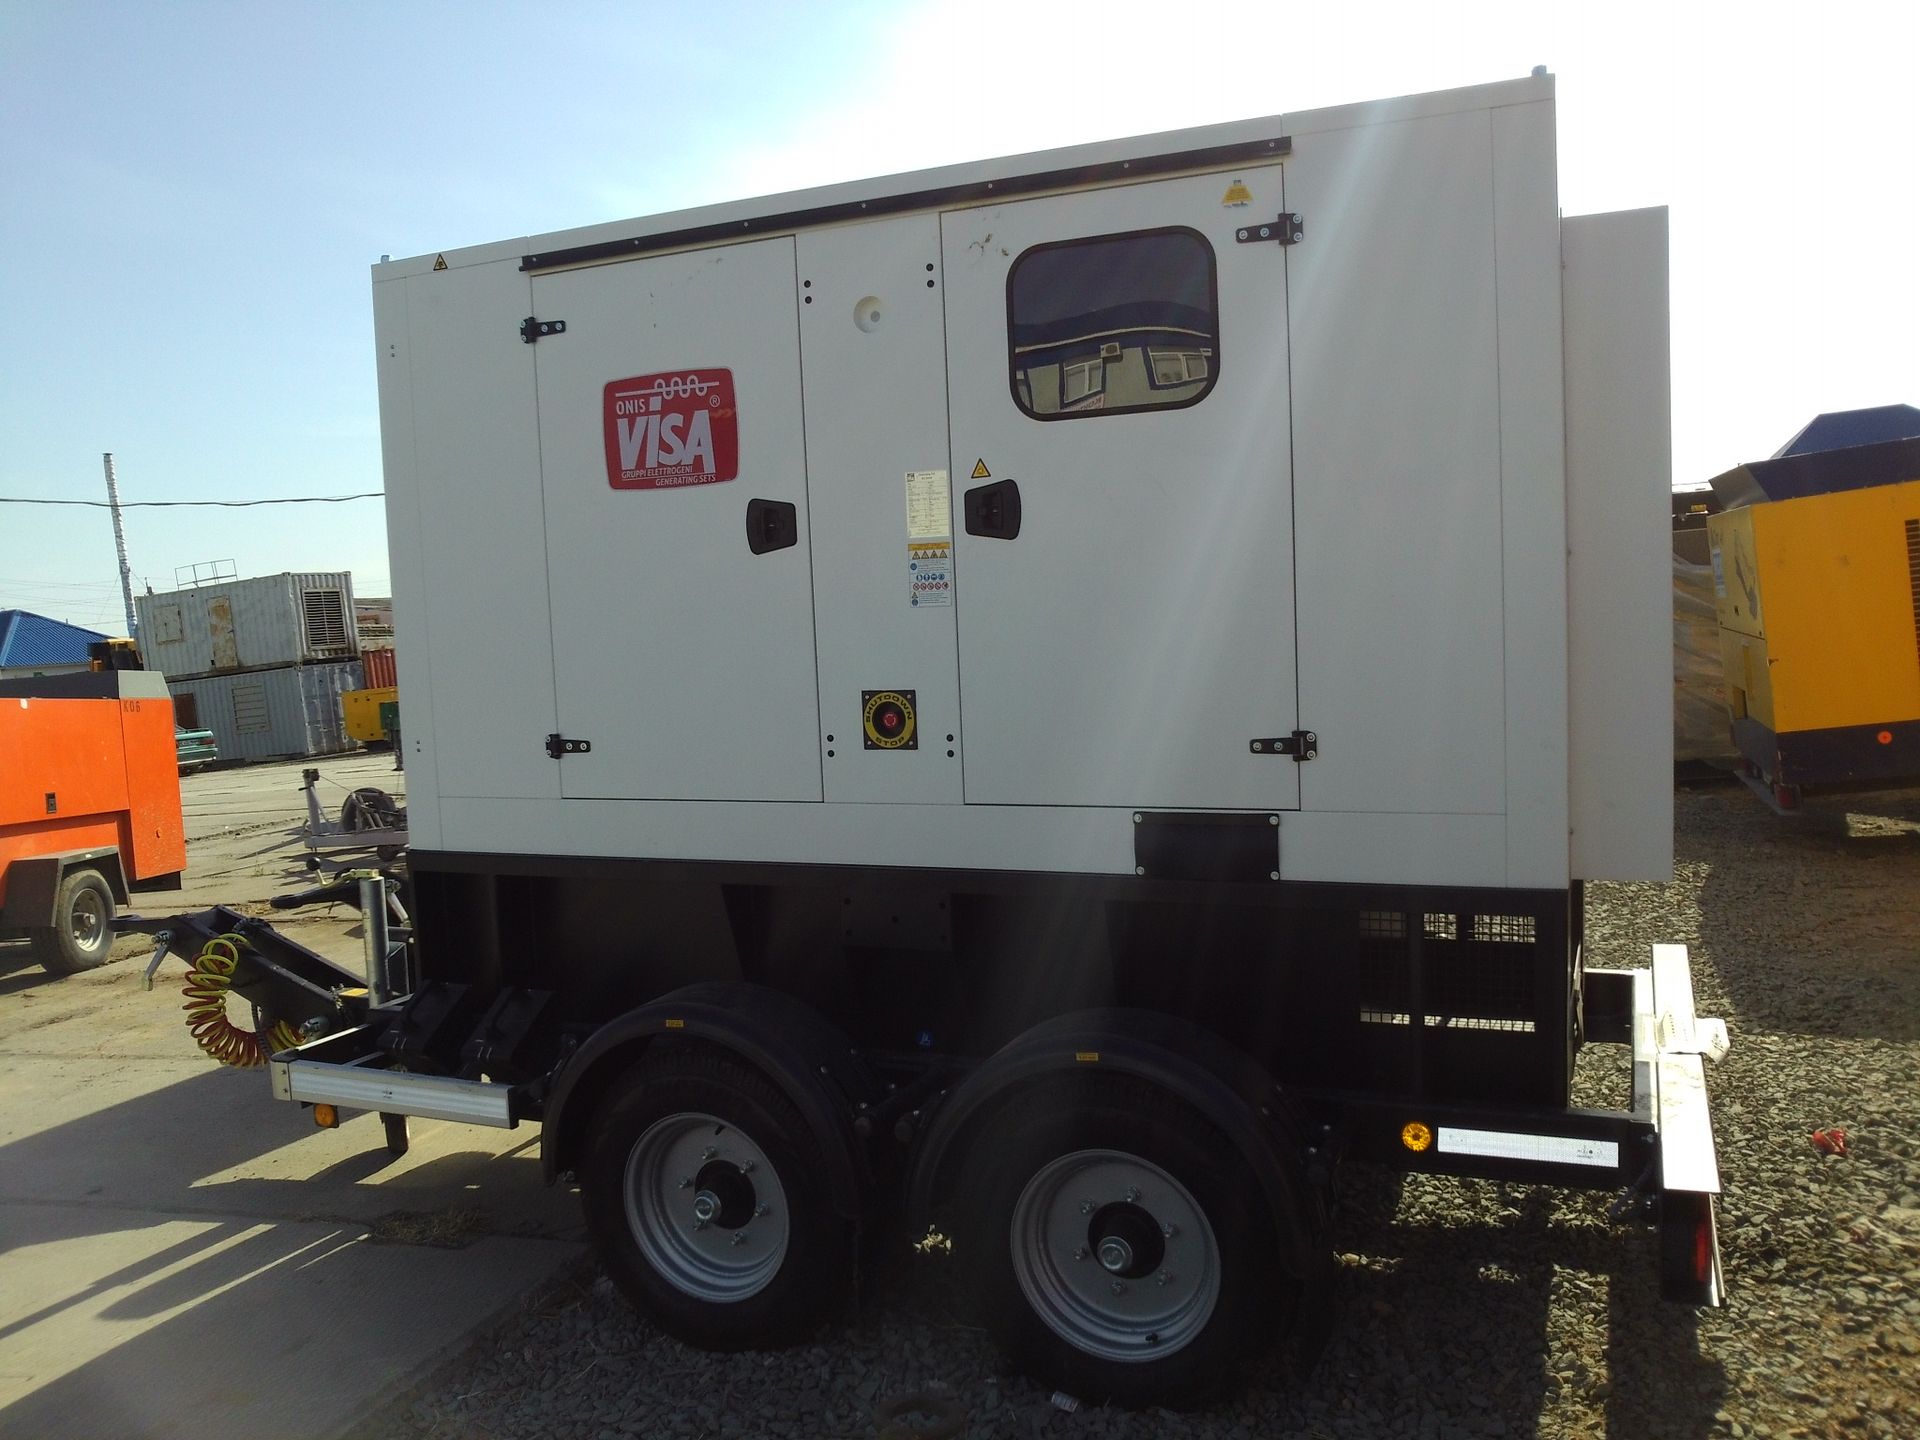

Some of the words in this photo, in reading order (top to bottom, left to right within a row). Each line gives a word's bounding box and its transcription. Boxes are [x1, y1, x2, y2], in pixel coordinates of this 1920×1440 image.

[616, 398, 646, 415] ONIS
[621, 470, 647, 479] GRUPPI
[647, 465, 693, 477] ELETTROGENI
[655, 475, 698, 487] GENERATING
[699, 474, 716, 483] SETS
[865, 694, 912, 723] SHUTDOWN
[875, 736, 905, 747] STOP
